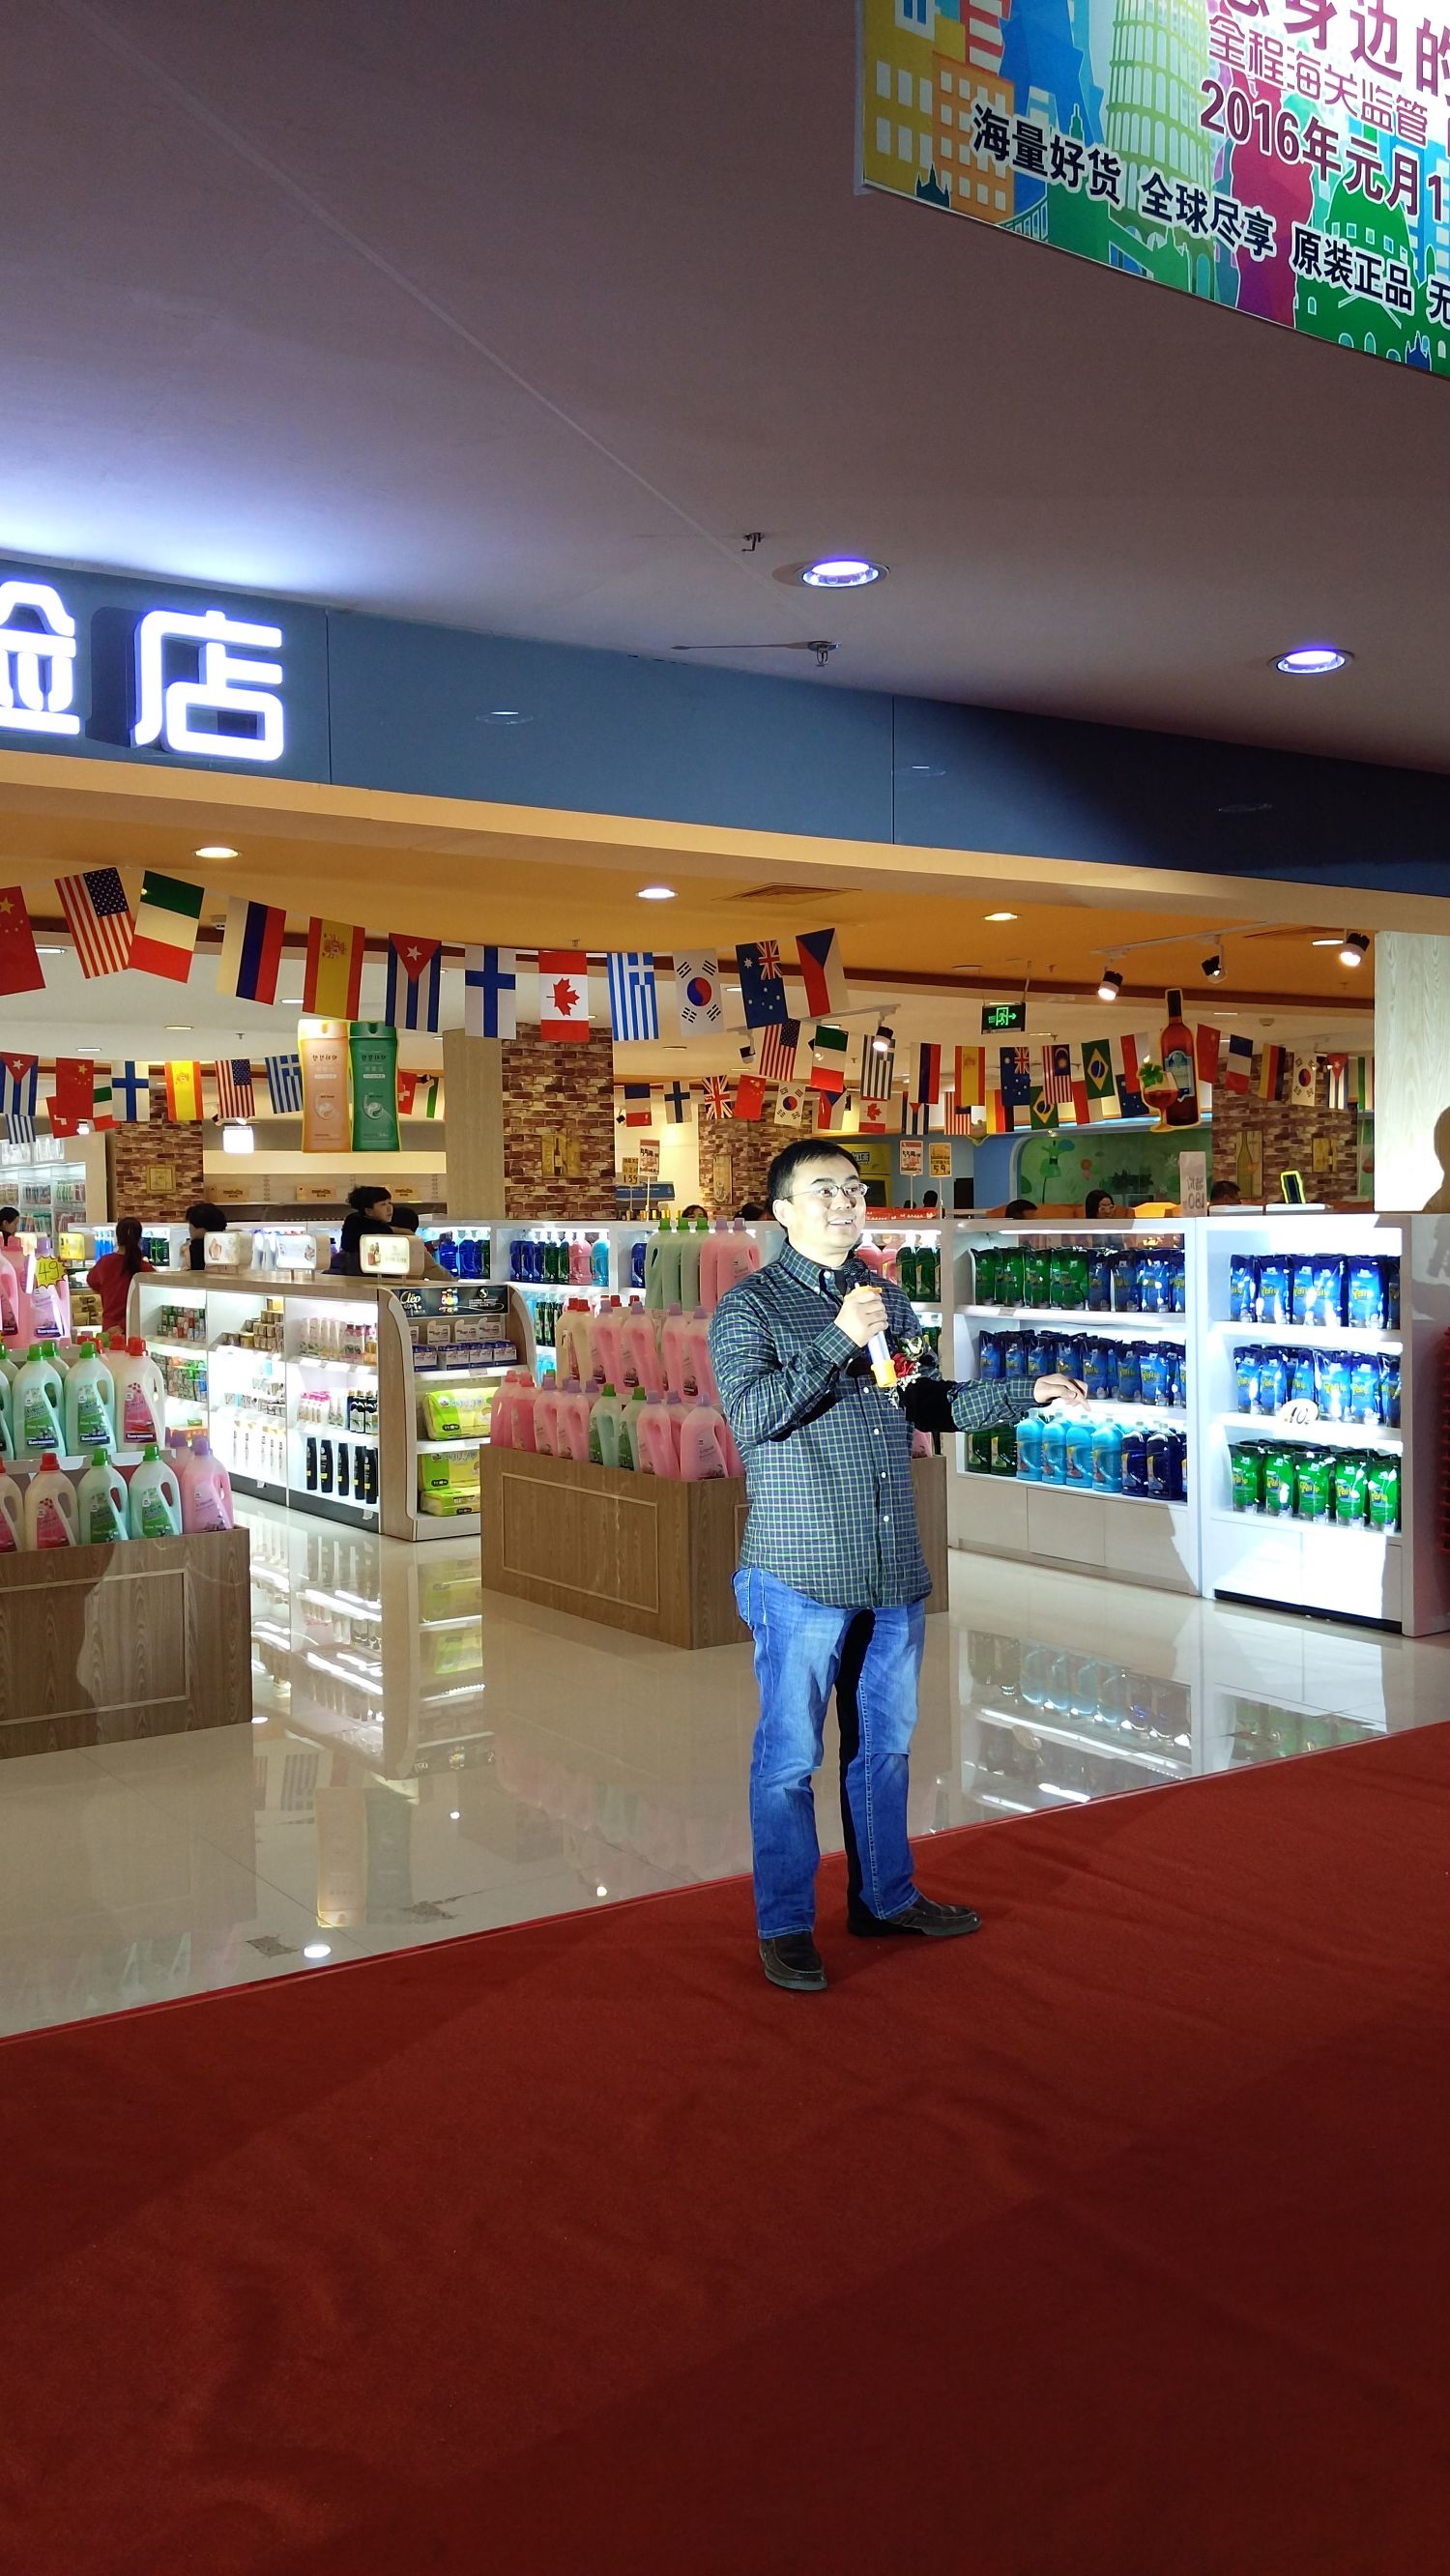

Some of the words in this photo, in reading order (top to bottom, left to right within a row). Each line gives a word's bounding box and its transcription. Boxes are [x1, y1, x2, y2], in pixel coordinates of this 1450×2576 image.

[1209, 15, 1427, 147] 全程海关监管
[1220, 0, 1450, 106] 身边的
[972, 104, 1122, 205] 海量好货
[1141, 174, 1275, 256] 全球尽享
[1292, 228, 1412, 311] 原装正品
[1201, 80, 1441, 221] 2016年元月1
[39, 1260, 60, 1281] 49
